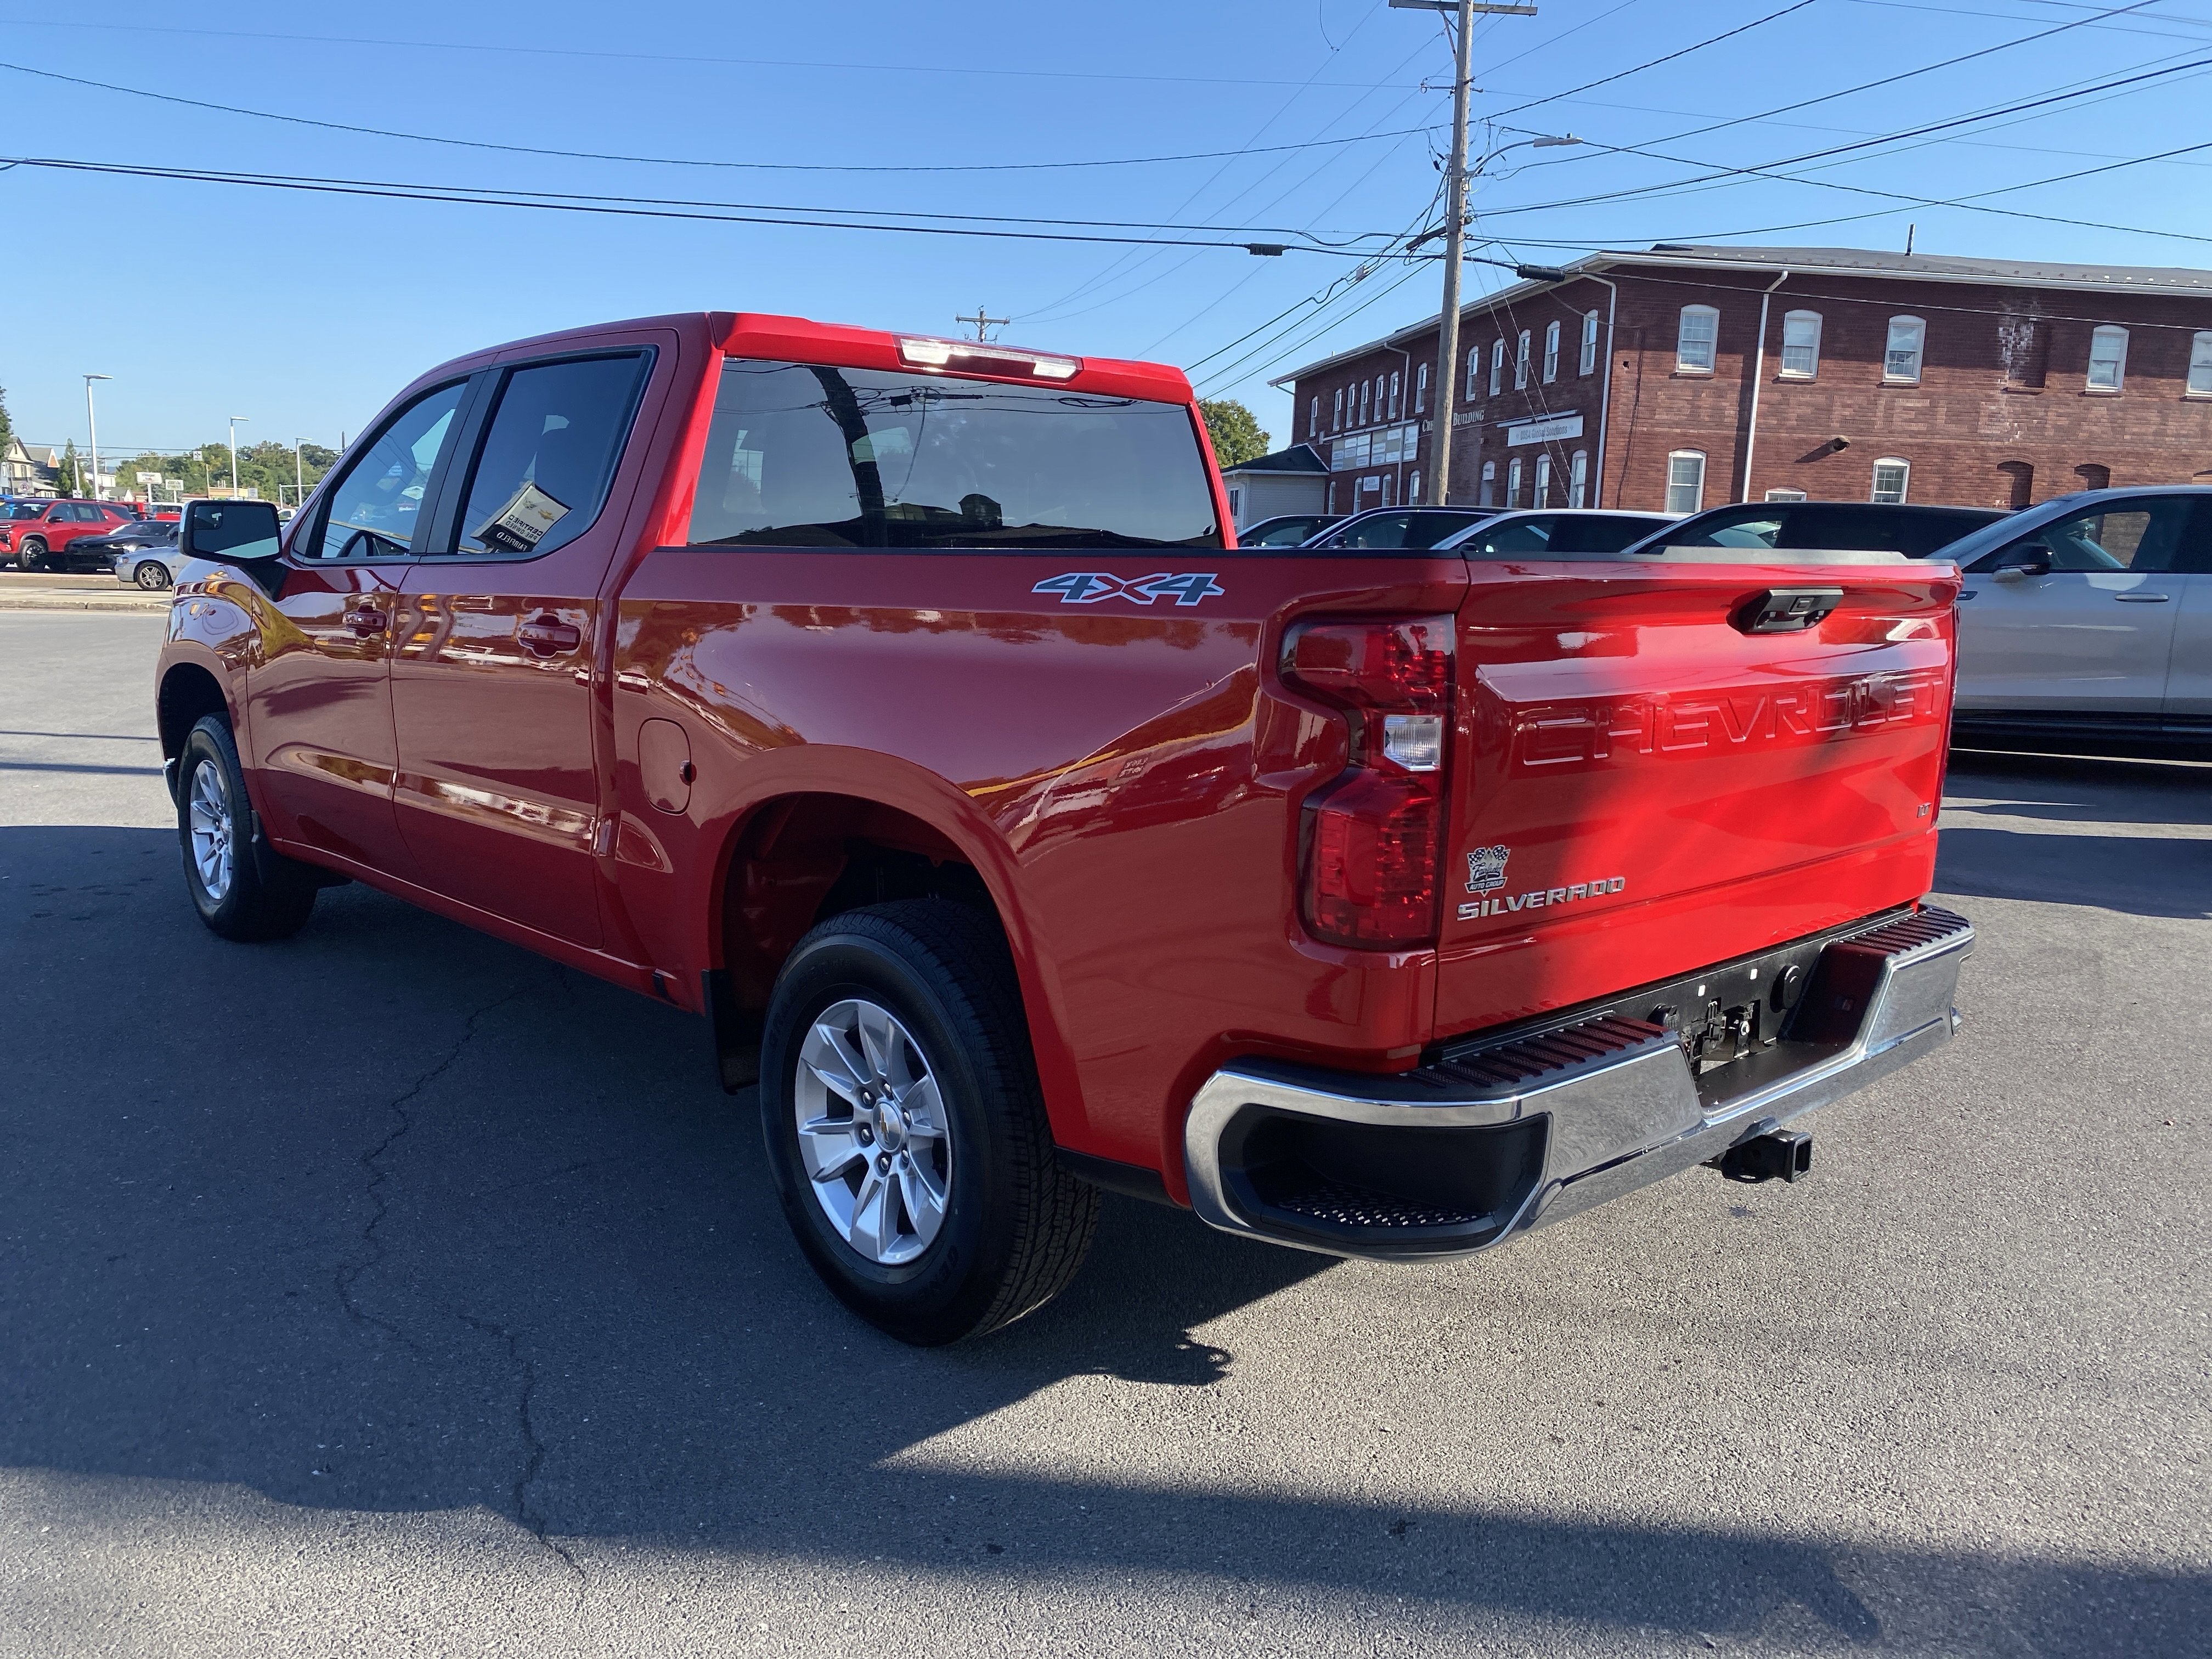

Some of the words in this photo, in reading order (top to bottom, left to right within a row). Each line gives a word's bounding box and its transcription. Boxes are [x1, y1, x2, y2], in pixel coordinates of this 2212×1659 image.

[1453, 410, 1484, 426] BUILDING
[1523, 675, 1943, 766] CHEVROLET
[1917, 802, 1932, 818] LT
[1457, 876, 1626, 922] SILVERADO
